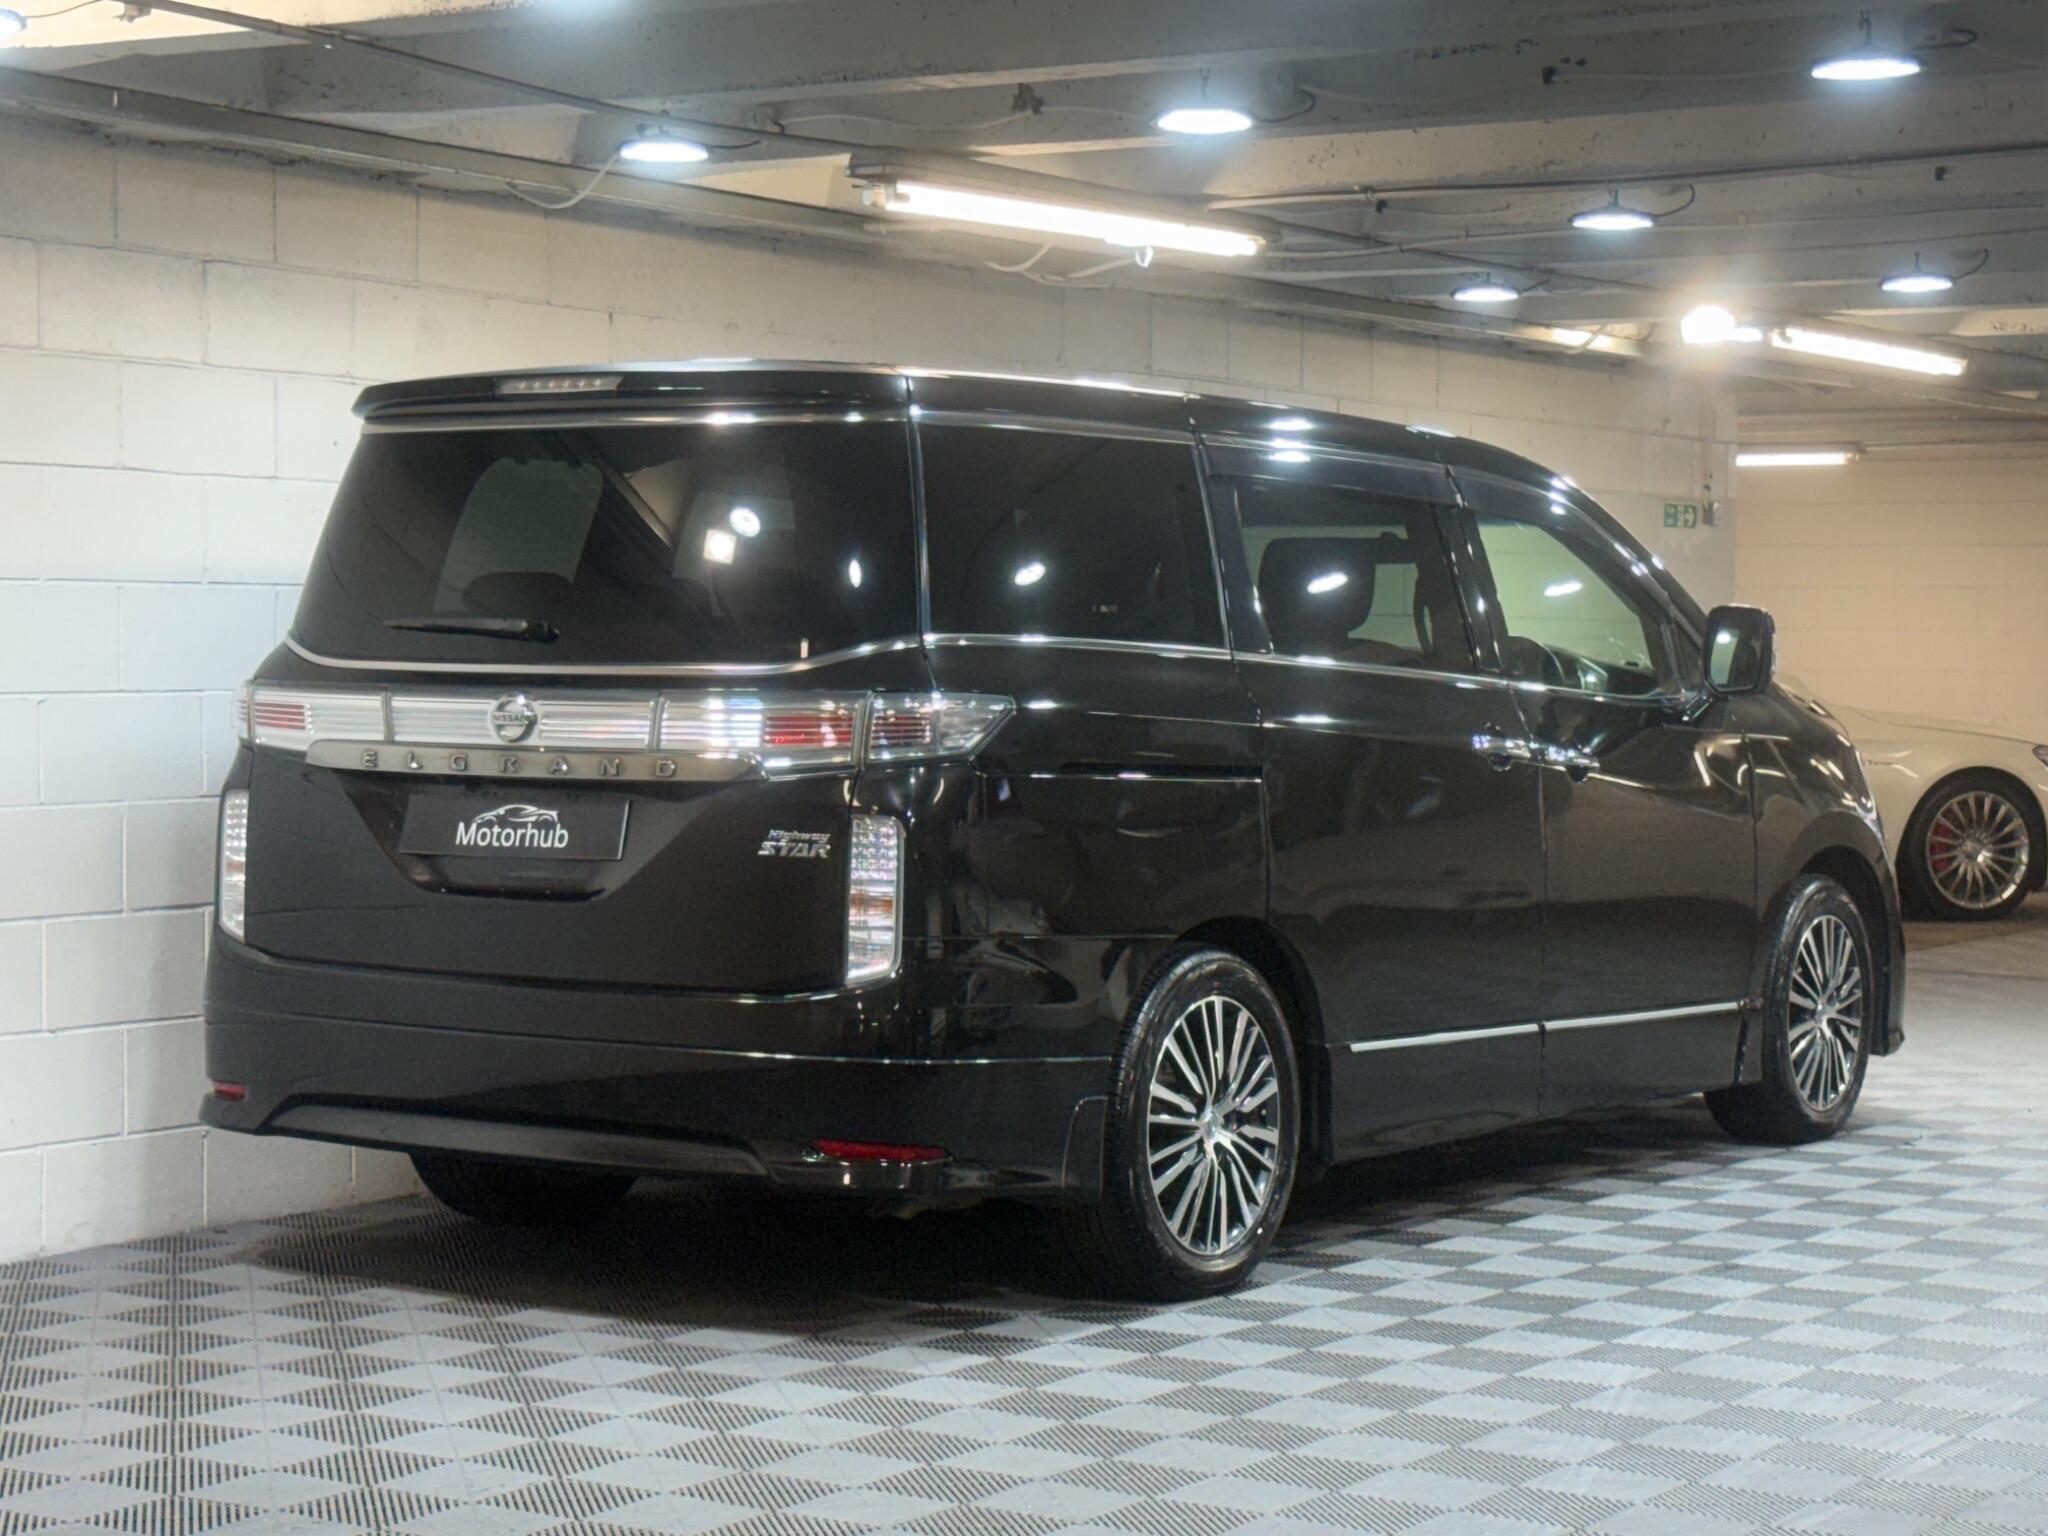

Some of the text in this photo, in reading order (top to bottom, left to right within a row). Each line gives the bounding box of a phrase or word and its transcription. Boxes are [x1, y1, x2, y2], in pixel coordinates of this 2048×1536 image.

[362, 749, 677, 777] ELGRAND
[455, 822, 569, 848] Motorhub
[757, 841, 832, 858] STAR
